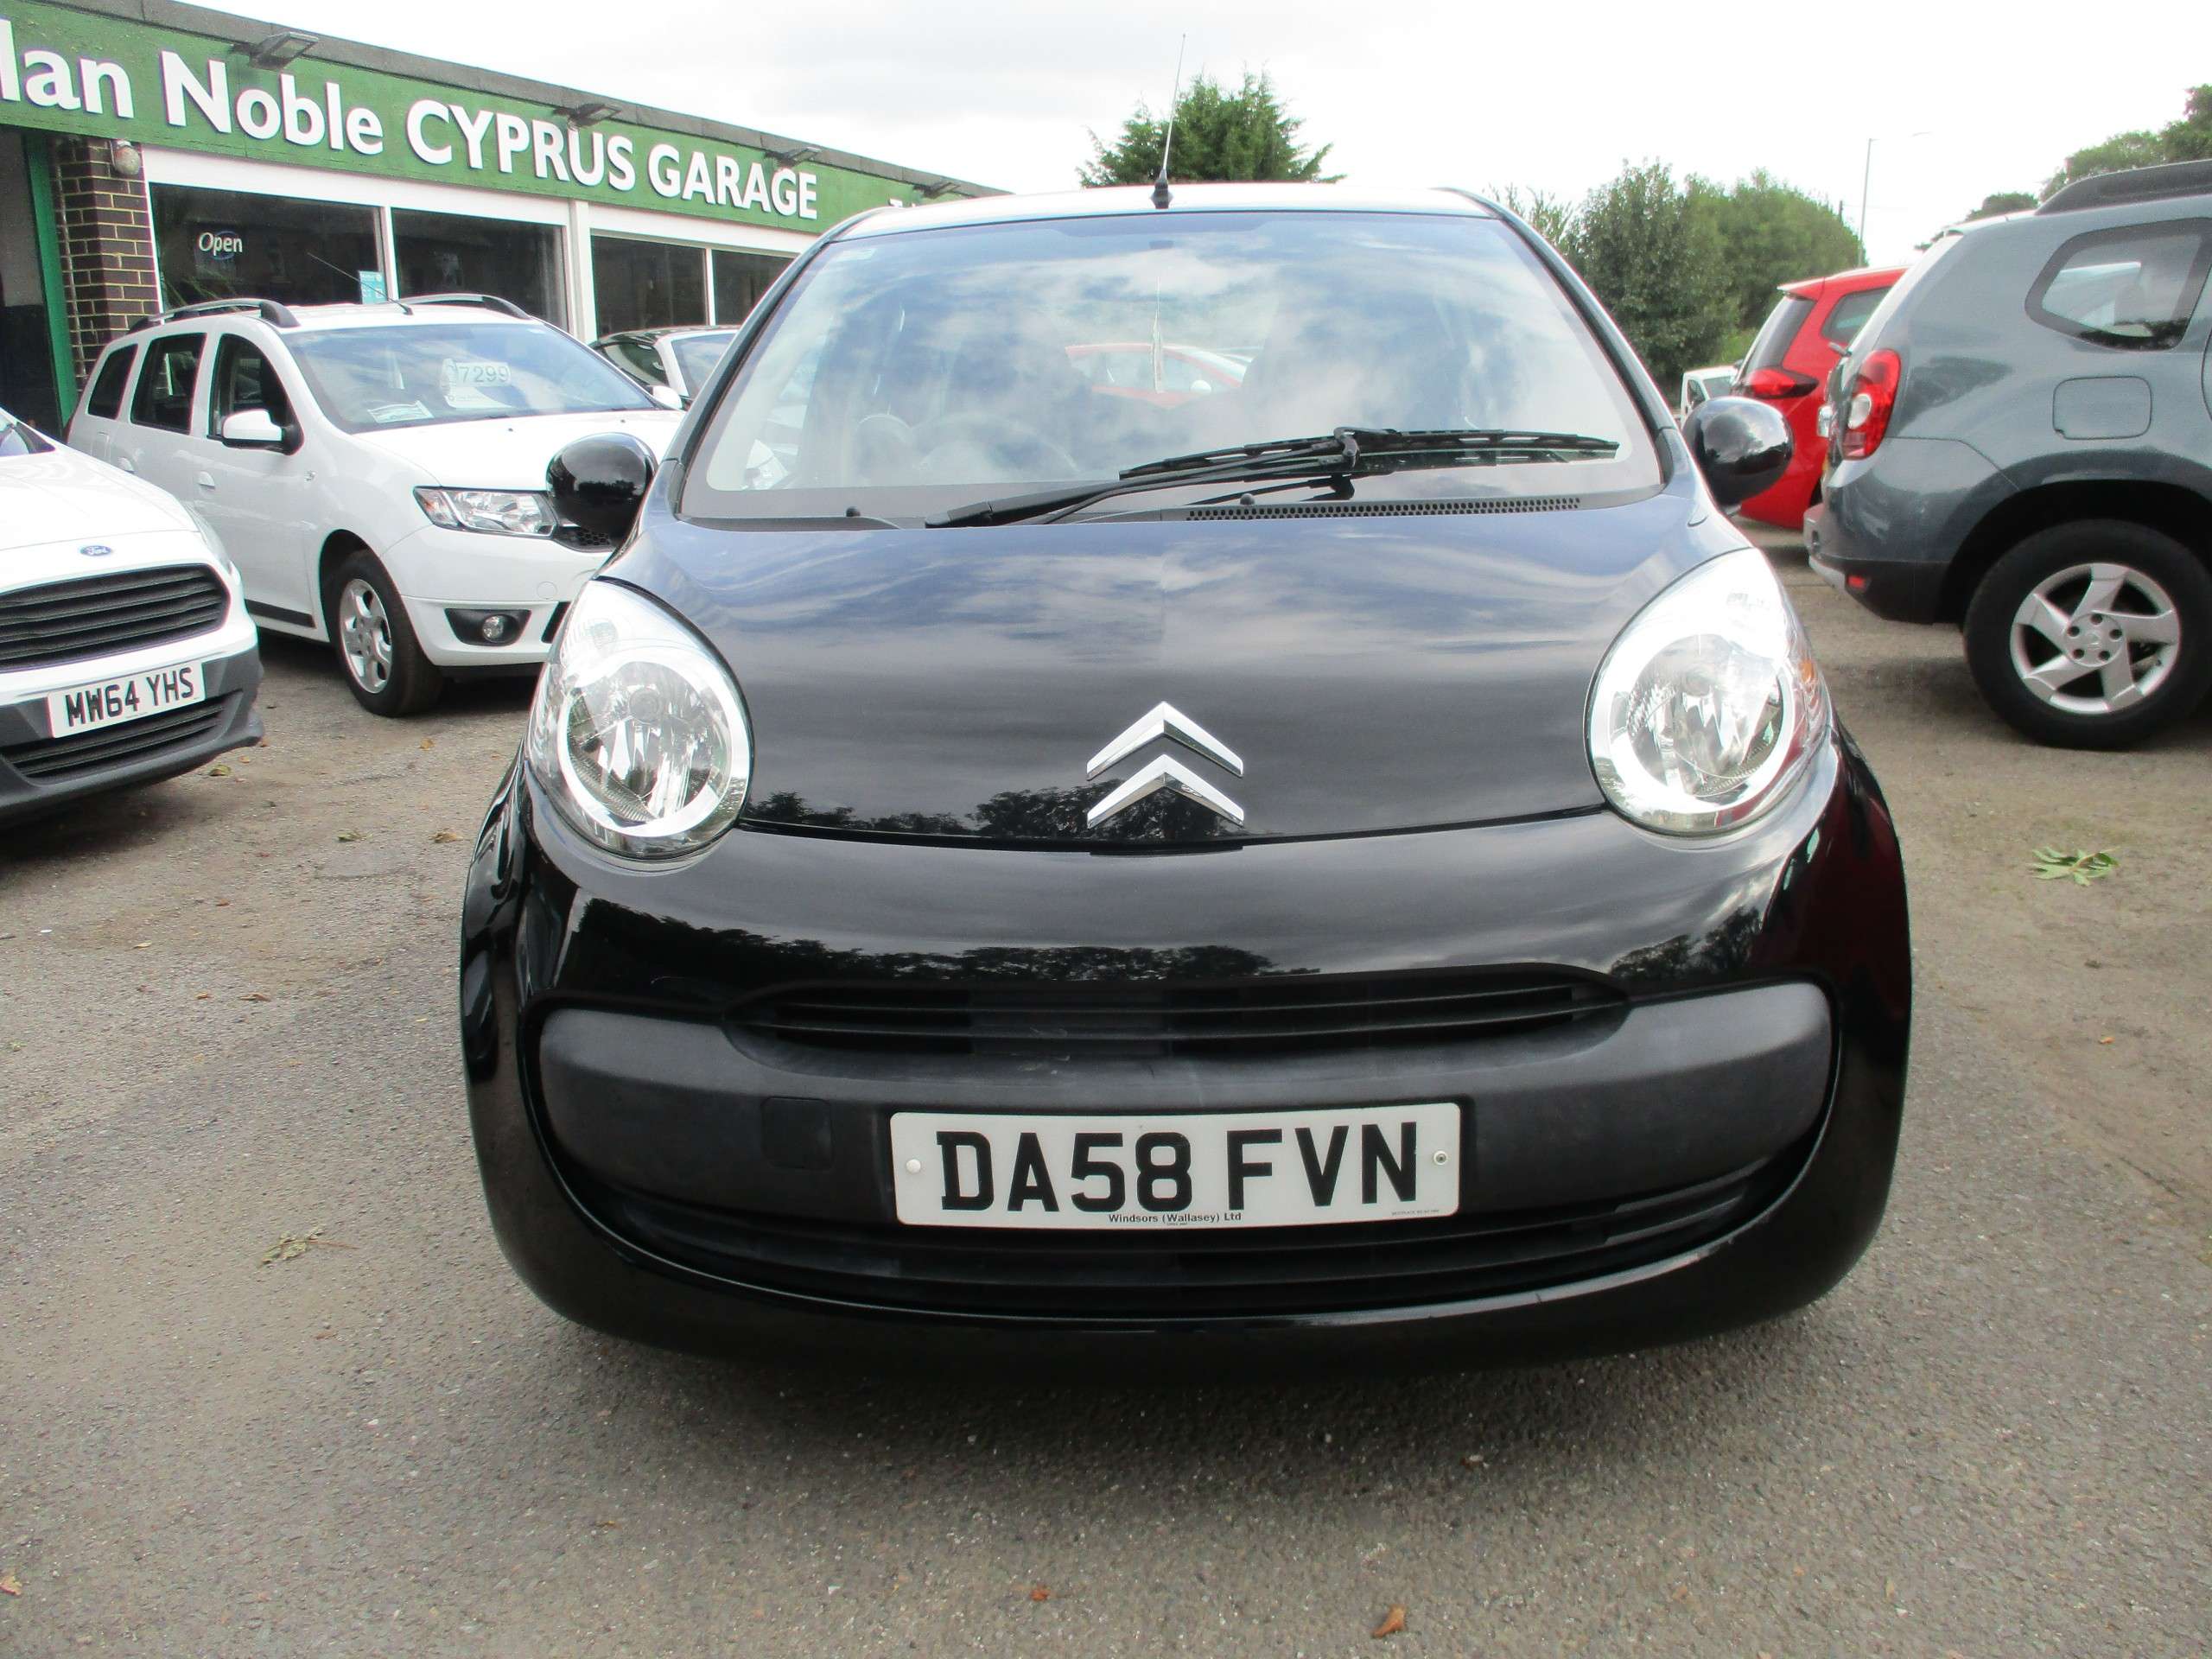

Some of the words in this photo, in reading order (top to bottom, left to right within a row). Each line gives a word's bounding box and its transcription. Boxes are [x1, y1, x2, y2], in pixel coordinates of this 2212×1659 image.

[161, 50, 384, 156] Noble
[406, 99, 636, 192] CYPRUS
[648, 143, 817, 220] GARAGE
[198, 232, 243, 257] Open
[458, 365, 510, 385] 7299
[66, 680, 140, 727] MW64
[146, 666, 194, 706] YHS
[936, 1130, 1193, 1212] DA58
[1227, 1121, 1418, 1210] FVN
[1108, 1213, 1159, 1223] Windsors
[1161, 1212, 1220, 1224] (Wallasey)
[1224, 1211, 1243, 1222] Ltd
